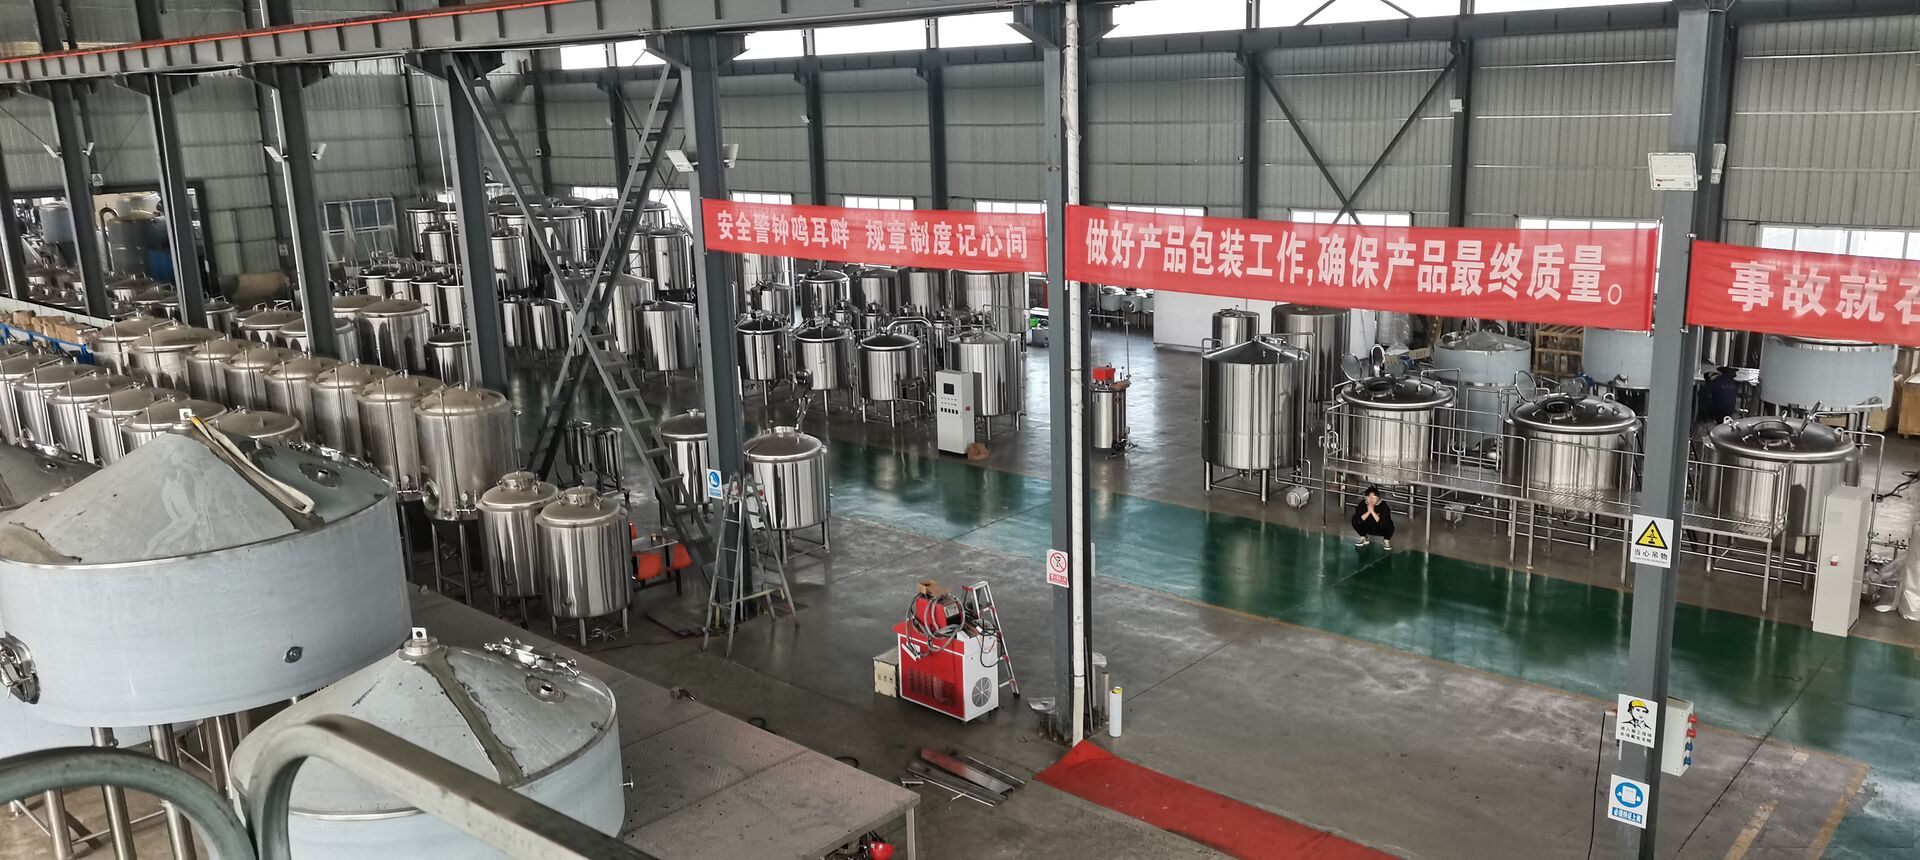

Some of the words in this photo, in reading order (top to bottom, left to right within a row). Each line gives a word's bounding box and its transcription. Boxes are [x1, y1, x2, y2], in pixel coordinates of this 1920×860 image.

[717, 209, 850, 250] 安全警钟鸣耳畔
[865, 217, 1028, 259] 规章制度记心间
